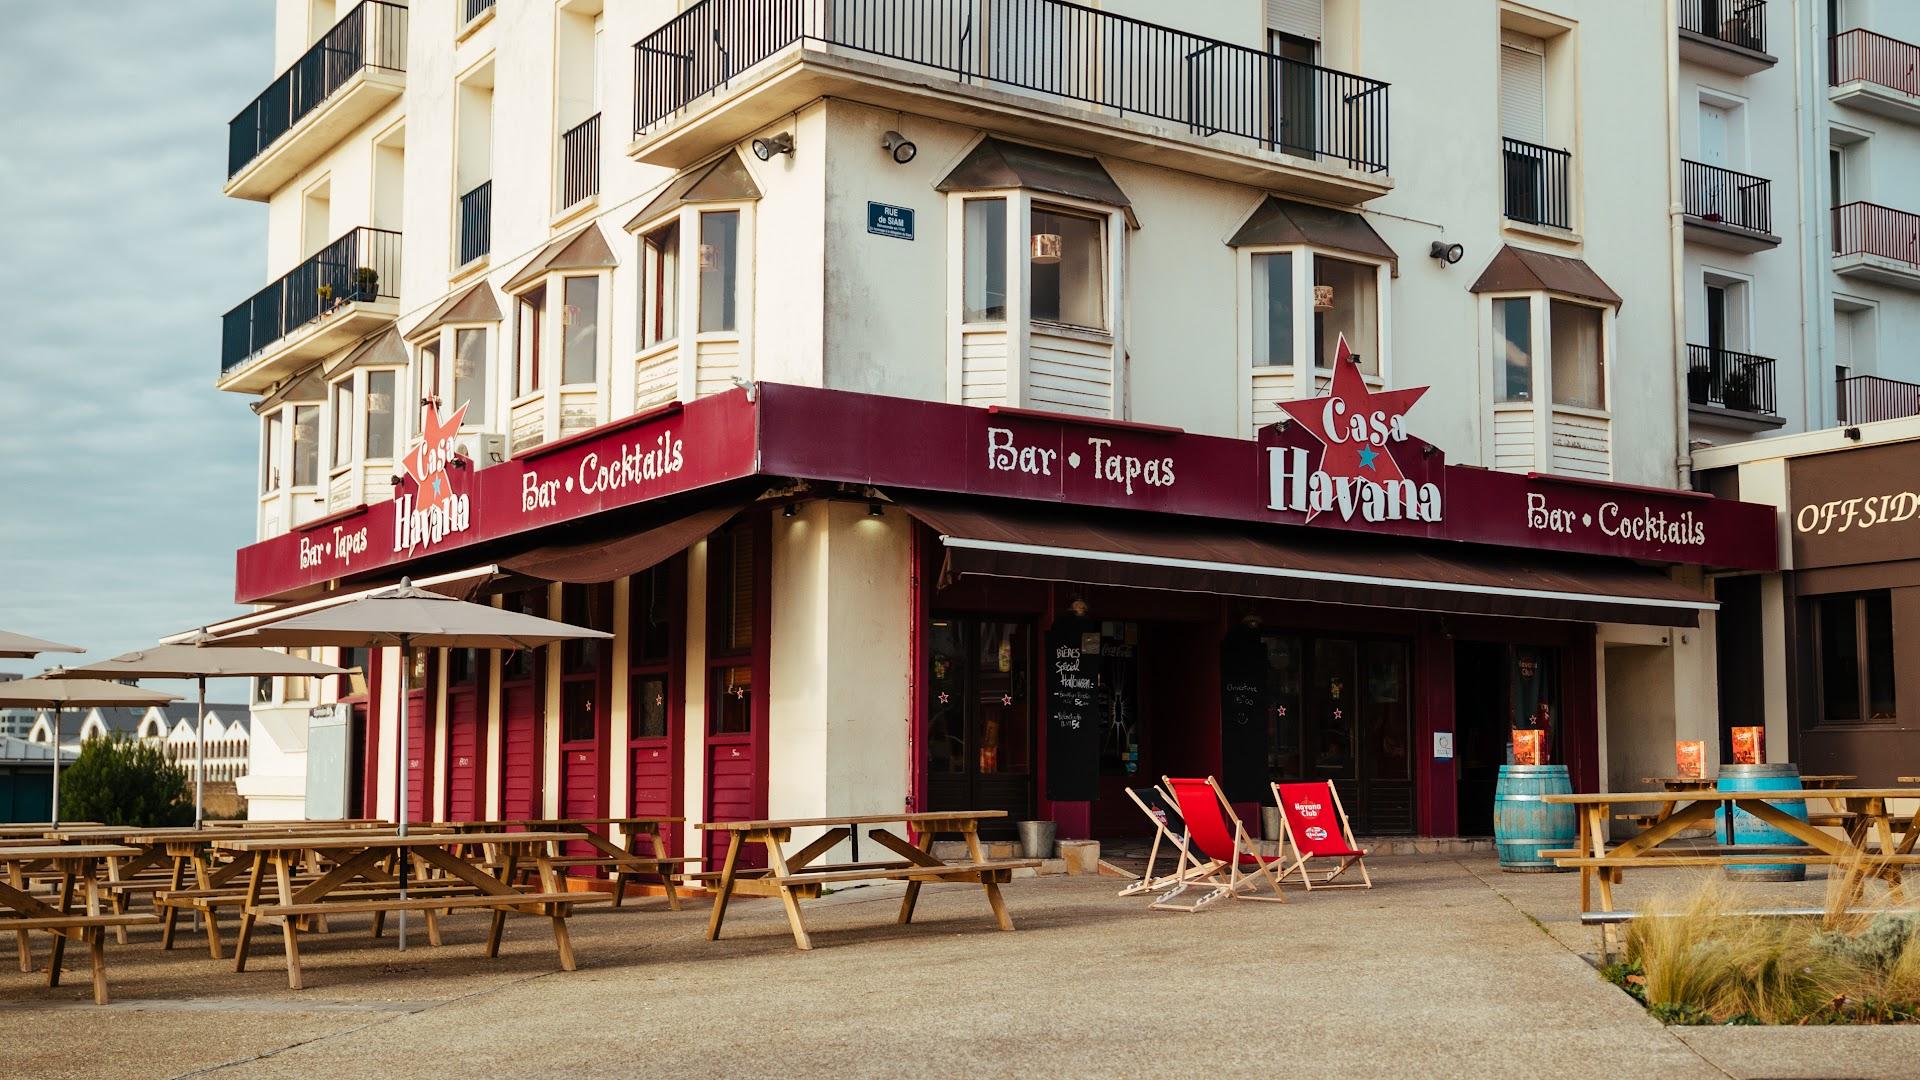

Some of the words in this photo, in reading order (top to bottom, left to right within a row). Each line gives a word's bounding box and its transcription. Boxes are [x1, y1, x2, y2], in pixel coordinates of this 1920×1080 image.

[878, 216, 887, 224] de
[887, 217, 904, 226] SIAM
[884, 207, 898, 216] RUE
[1322, 397, 1408, 444] Casa
[417, 436, 454, 481] Casa
[522, 471, 560, 512] Bar
[578, 430, 684, 495] Cocktails
[987, 427, 1057, 477] Bar
[1088, 437, 1176, 496] Tapas
[1266, 446, 1443, 523] Havana
[393, 493, 470, 552] Havana
[1527, 492, 1576, 534] Bar
[1598, 501, 1706, 546] Cocktails
[299, 536, 324, 570] Bar
[333, 525, 368, 566] Tapas
[1294, 803, 1322, 811] Havana
